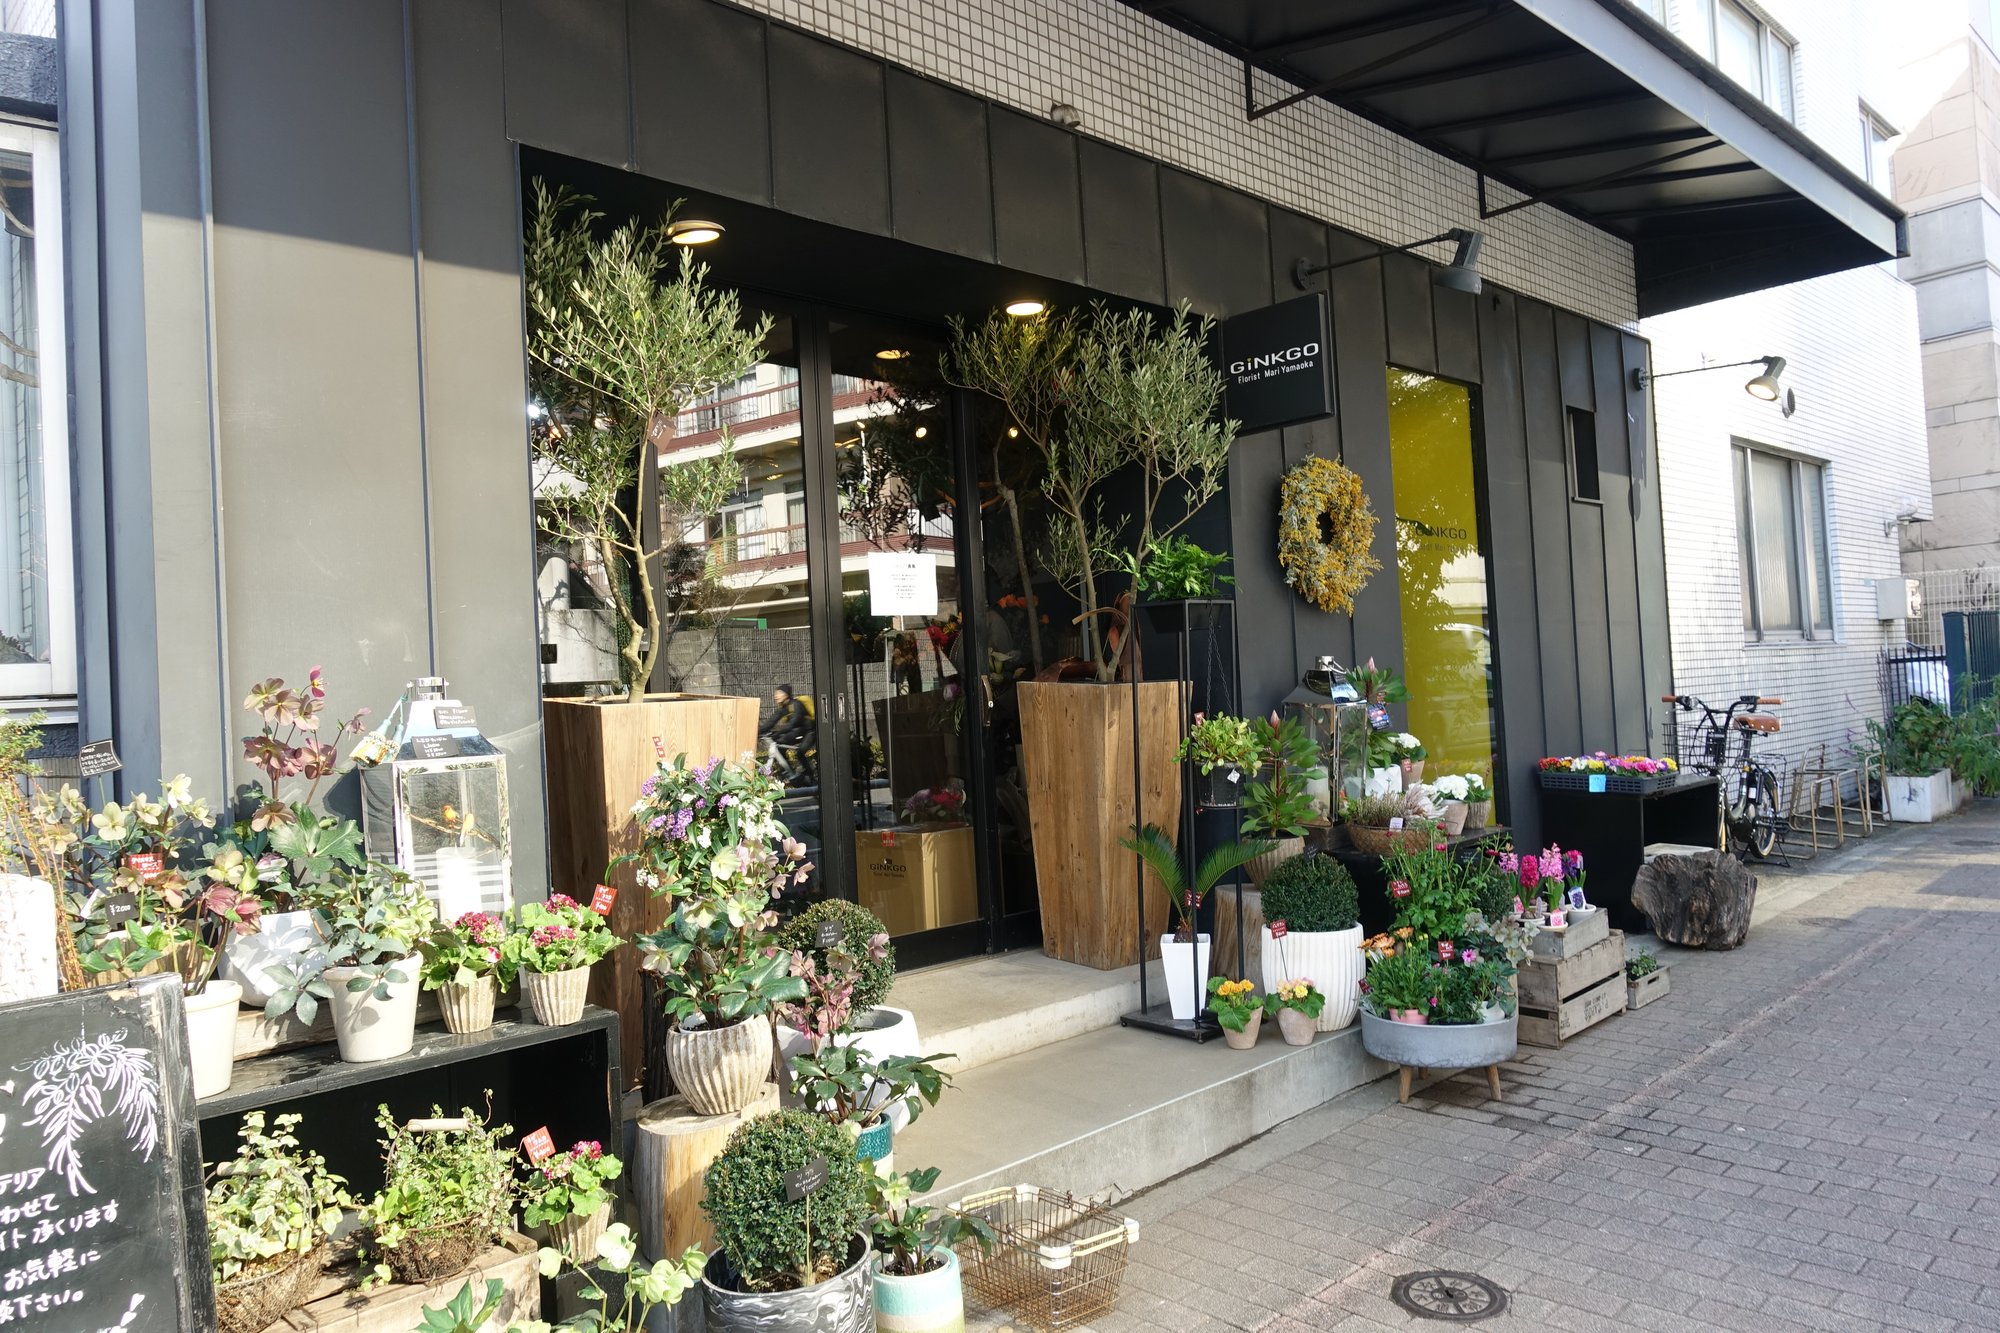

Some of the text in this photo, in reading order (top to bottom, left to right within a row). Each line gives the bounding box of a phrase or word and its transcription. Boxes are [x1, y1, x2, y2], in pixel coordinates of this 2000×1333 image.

[1237, 360, 1314, 385] Florist Mari Yamaoka
[4, 1247, 102, 1292] お気軽に
